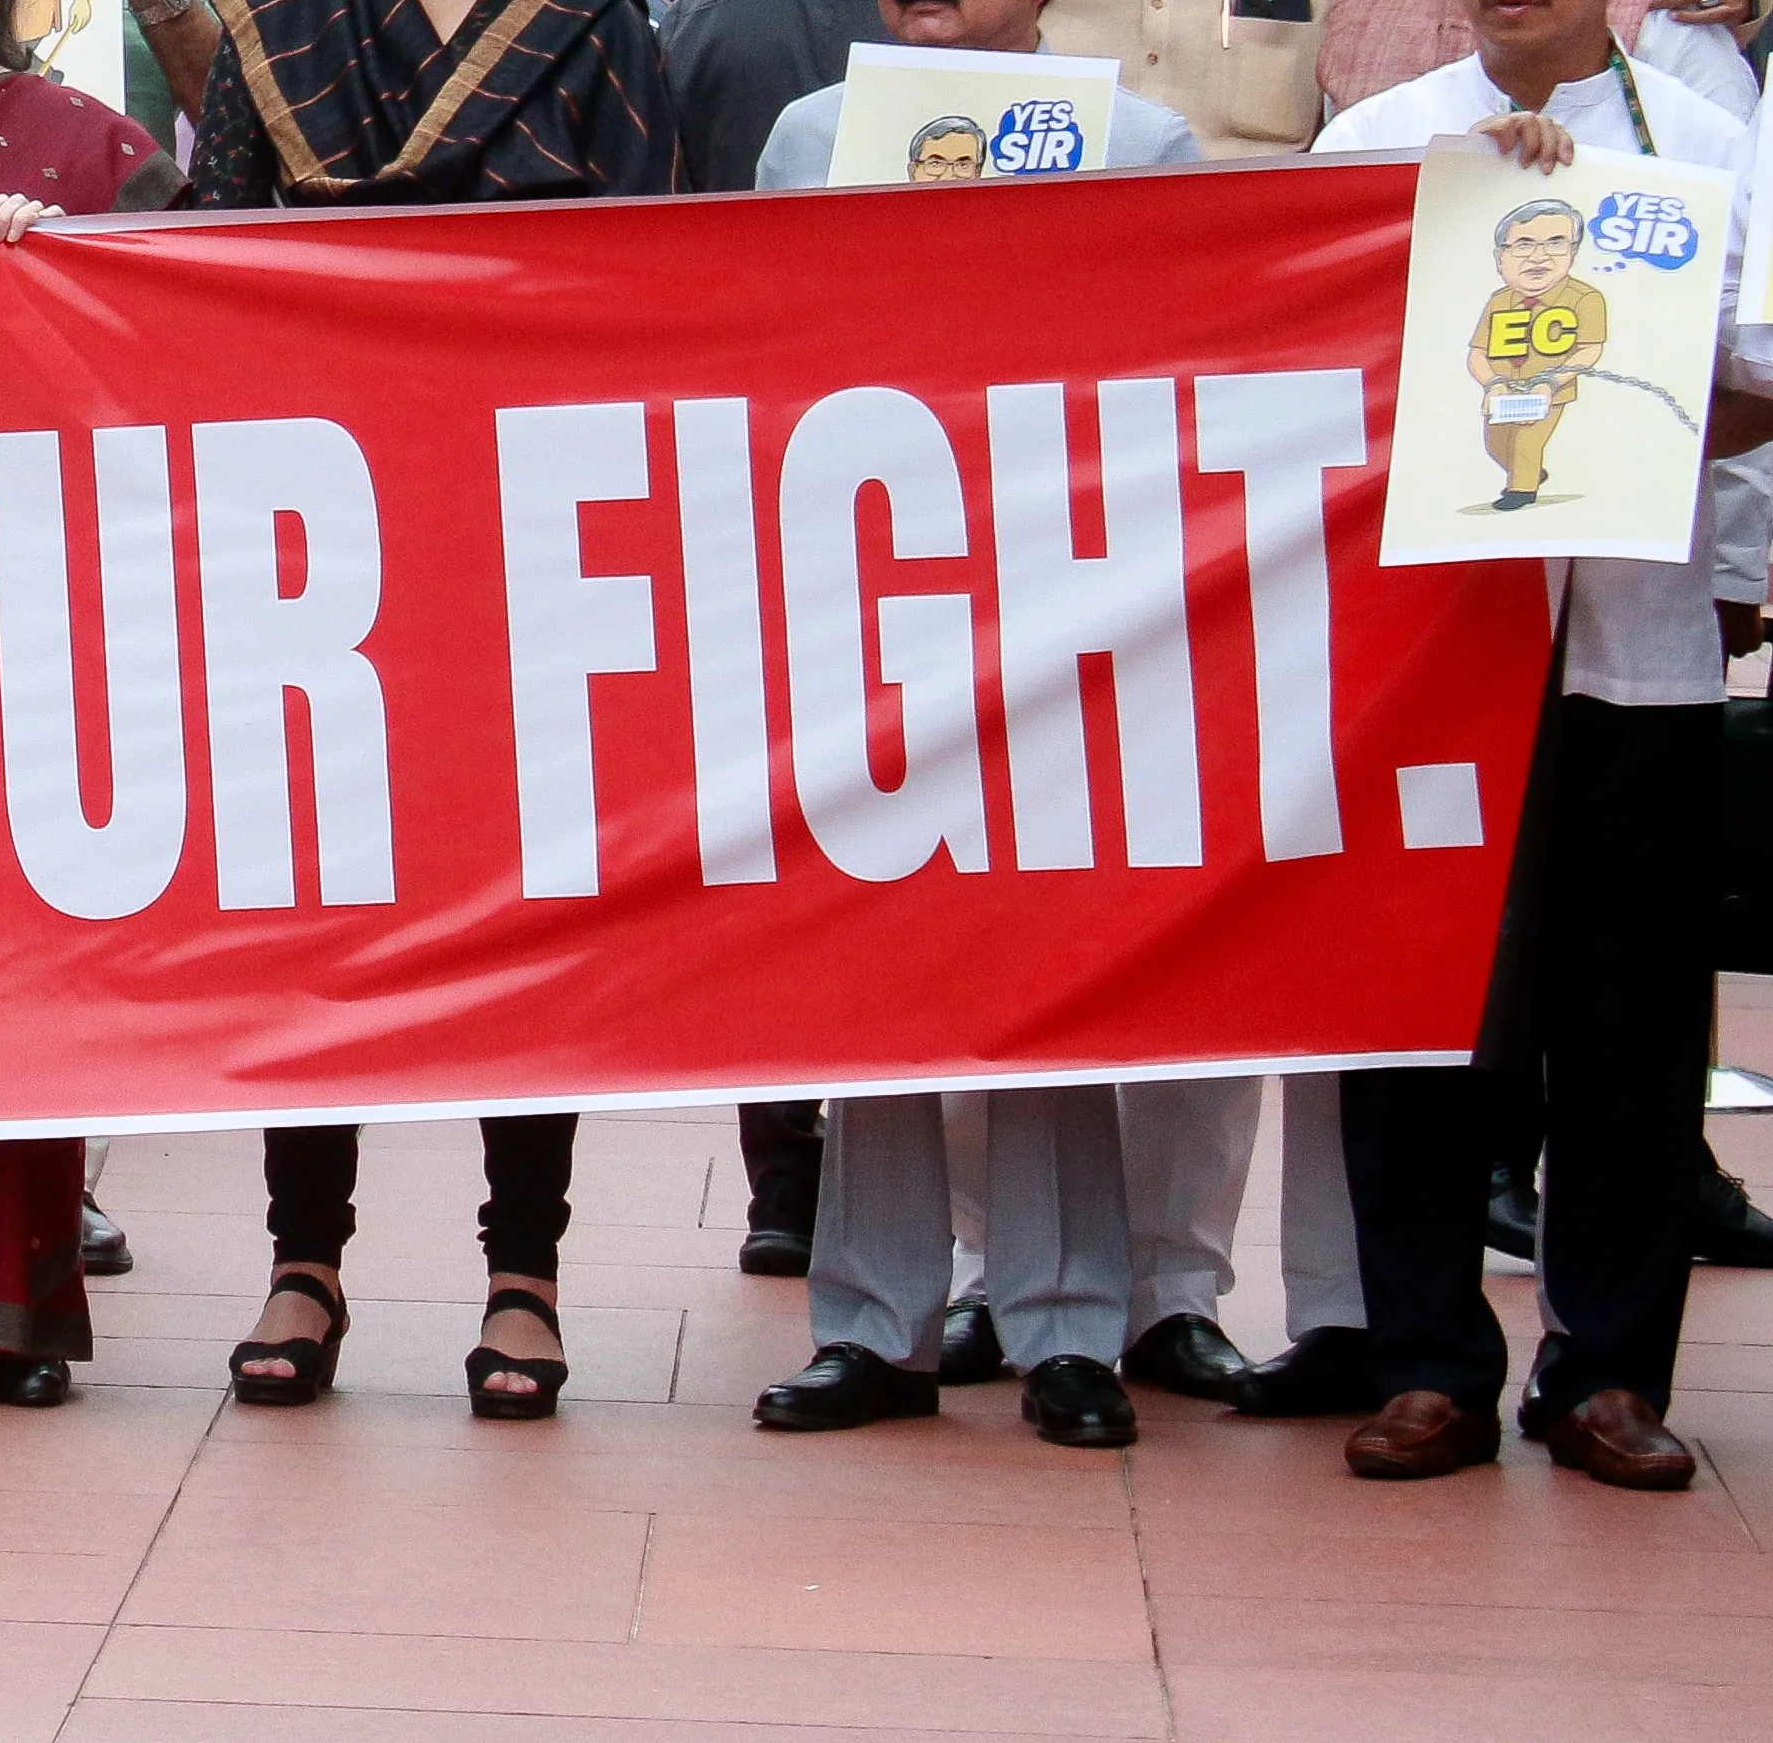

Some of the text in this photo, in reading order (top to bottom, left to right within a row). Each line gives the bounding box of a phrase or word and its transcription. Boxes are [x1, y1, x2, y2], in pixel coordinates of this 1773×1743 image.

[1010, 100, 1073, 133] YES
[995, 130, 1076, 172] SIR
[1611, 192, 1685, 222] YES
[1595, 214, 1690, 258] SIR
[1488, 306, 1579, 360] EC
[494, 367, 1484, 900] FIGHT.
